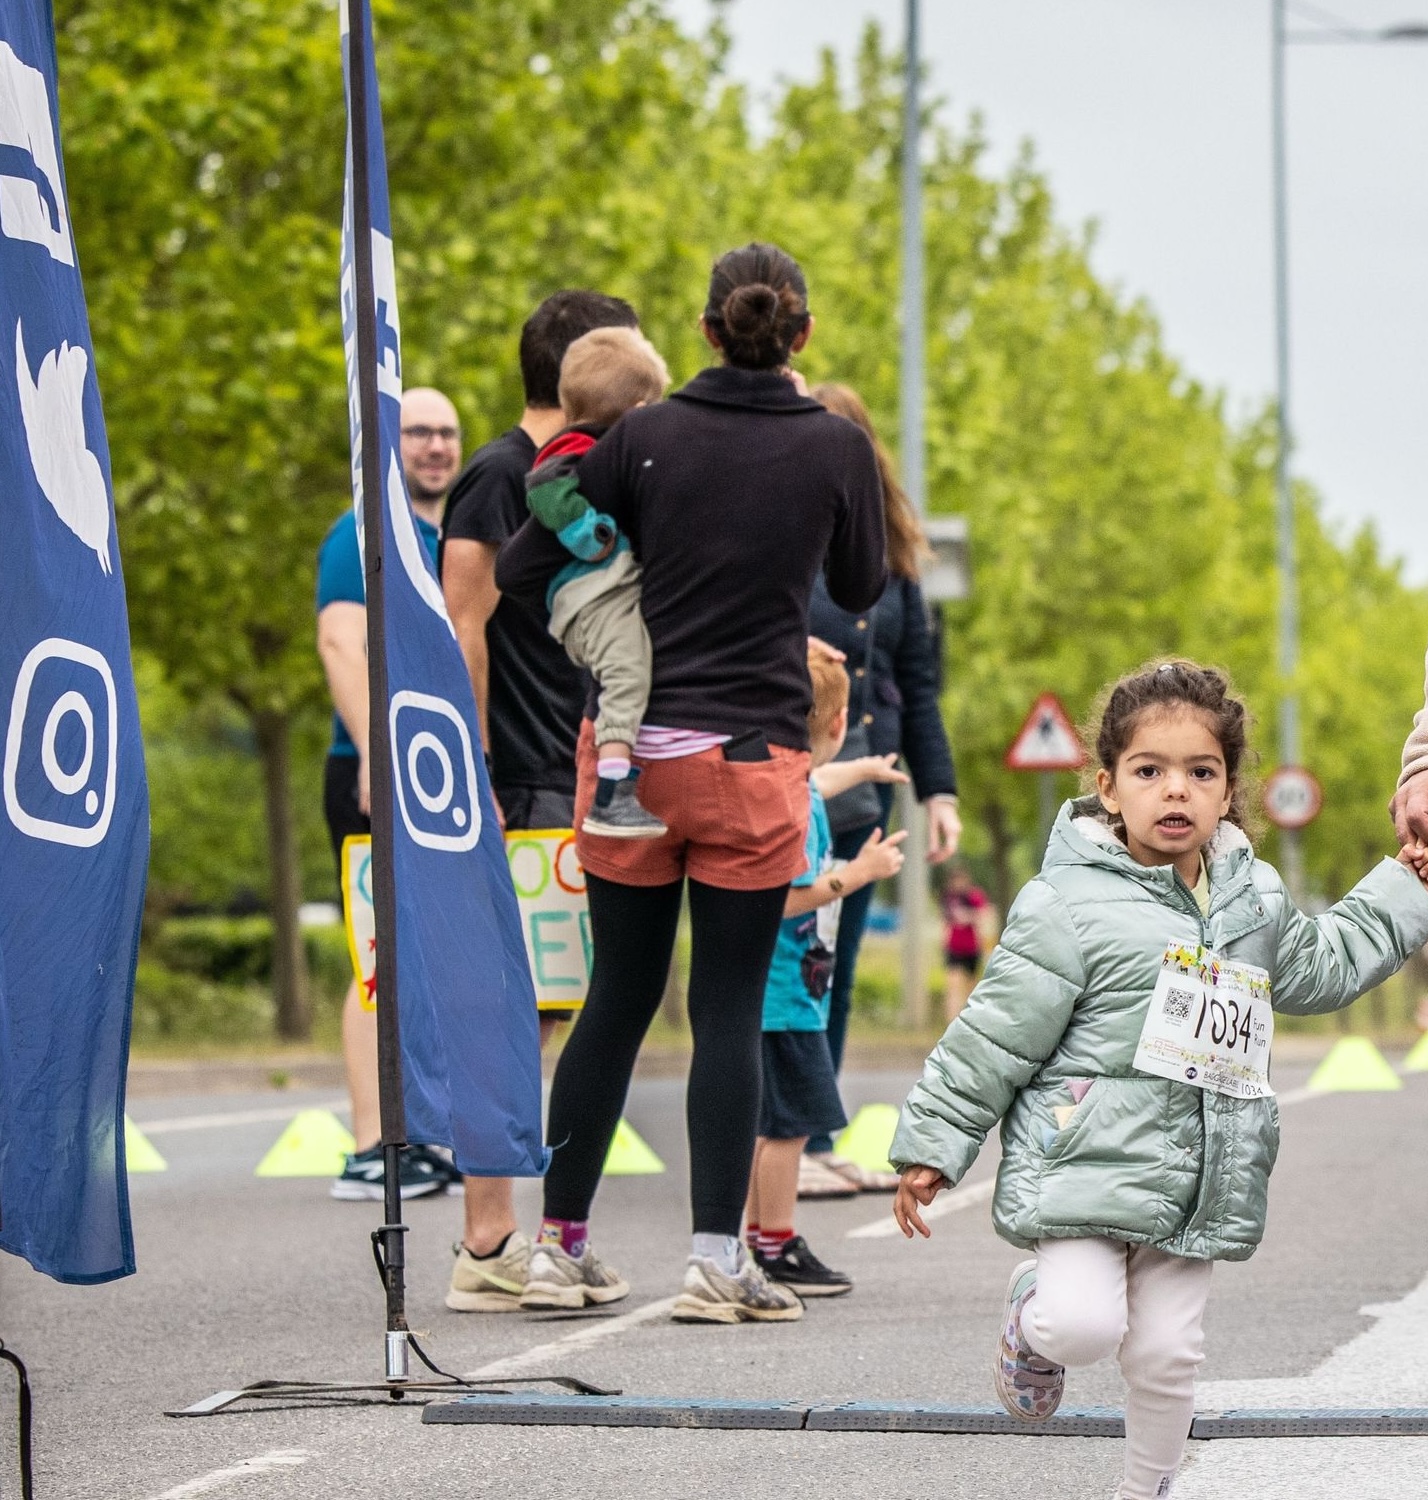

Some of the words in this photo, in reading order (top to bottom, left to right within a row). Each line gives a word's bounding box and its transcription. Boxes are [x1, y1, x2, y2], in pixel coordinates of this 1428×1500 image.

[1194, 991, 1252, 1054] 1034
[1253, 1017, 1265, 1032] Fun
[1254, 1036, 1267, 1048] Run
[1241, 1083, 1264, 1096] 1034
